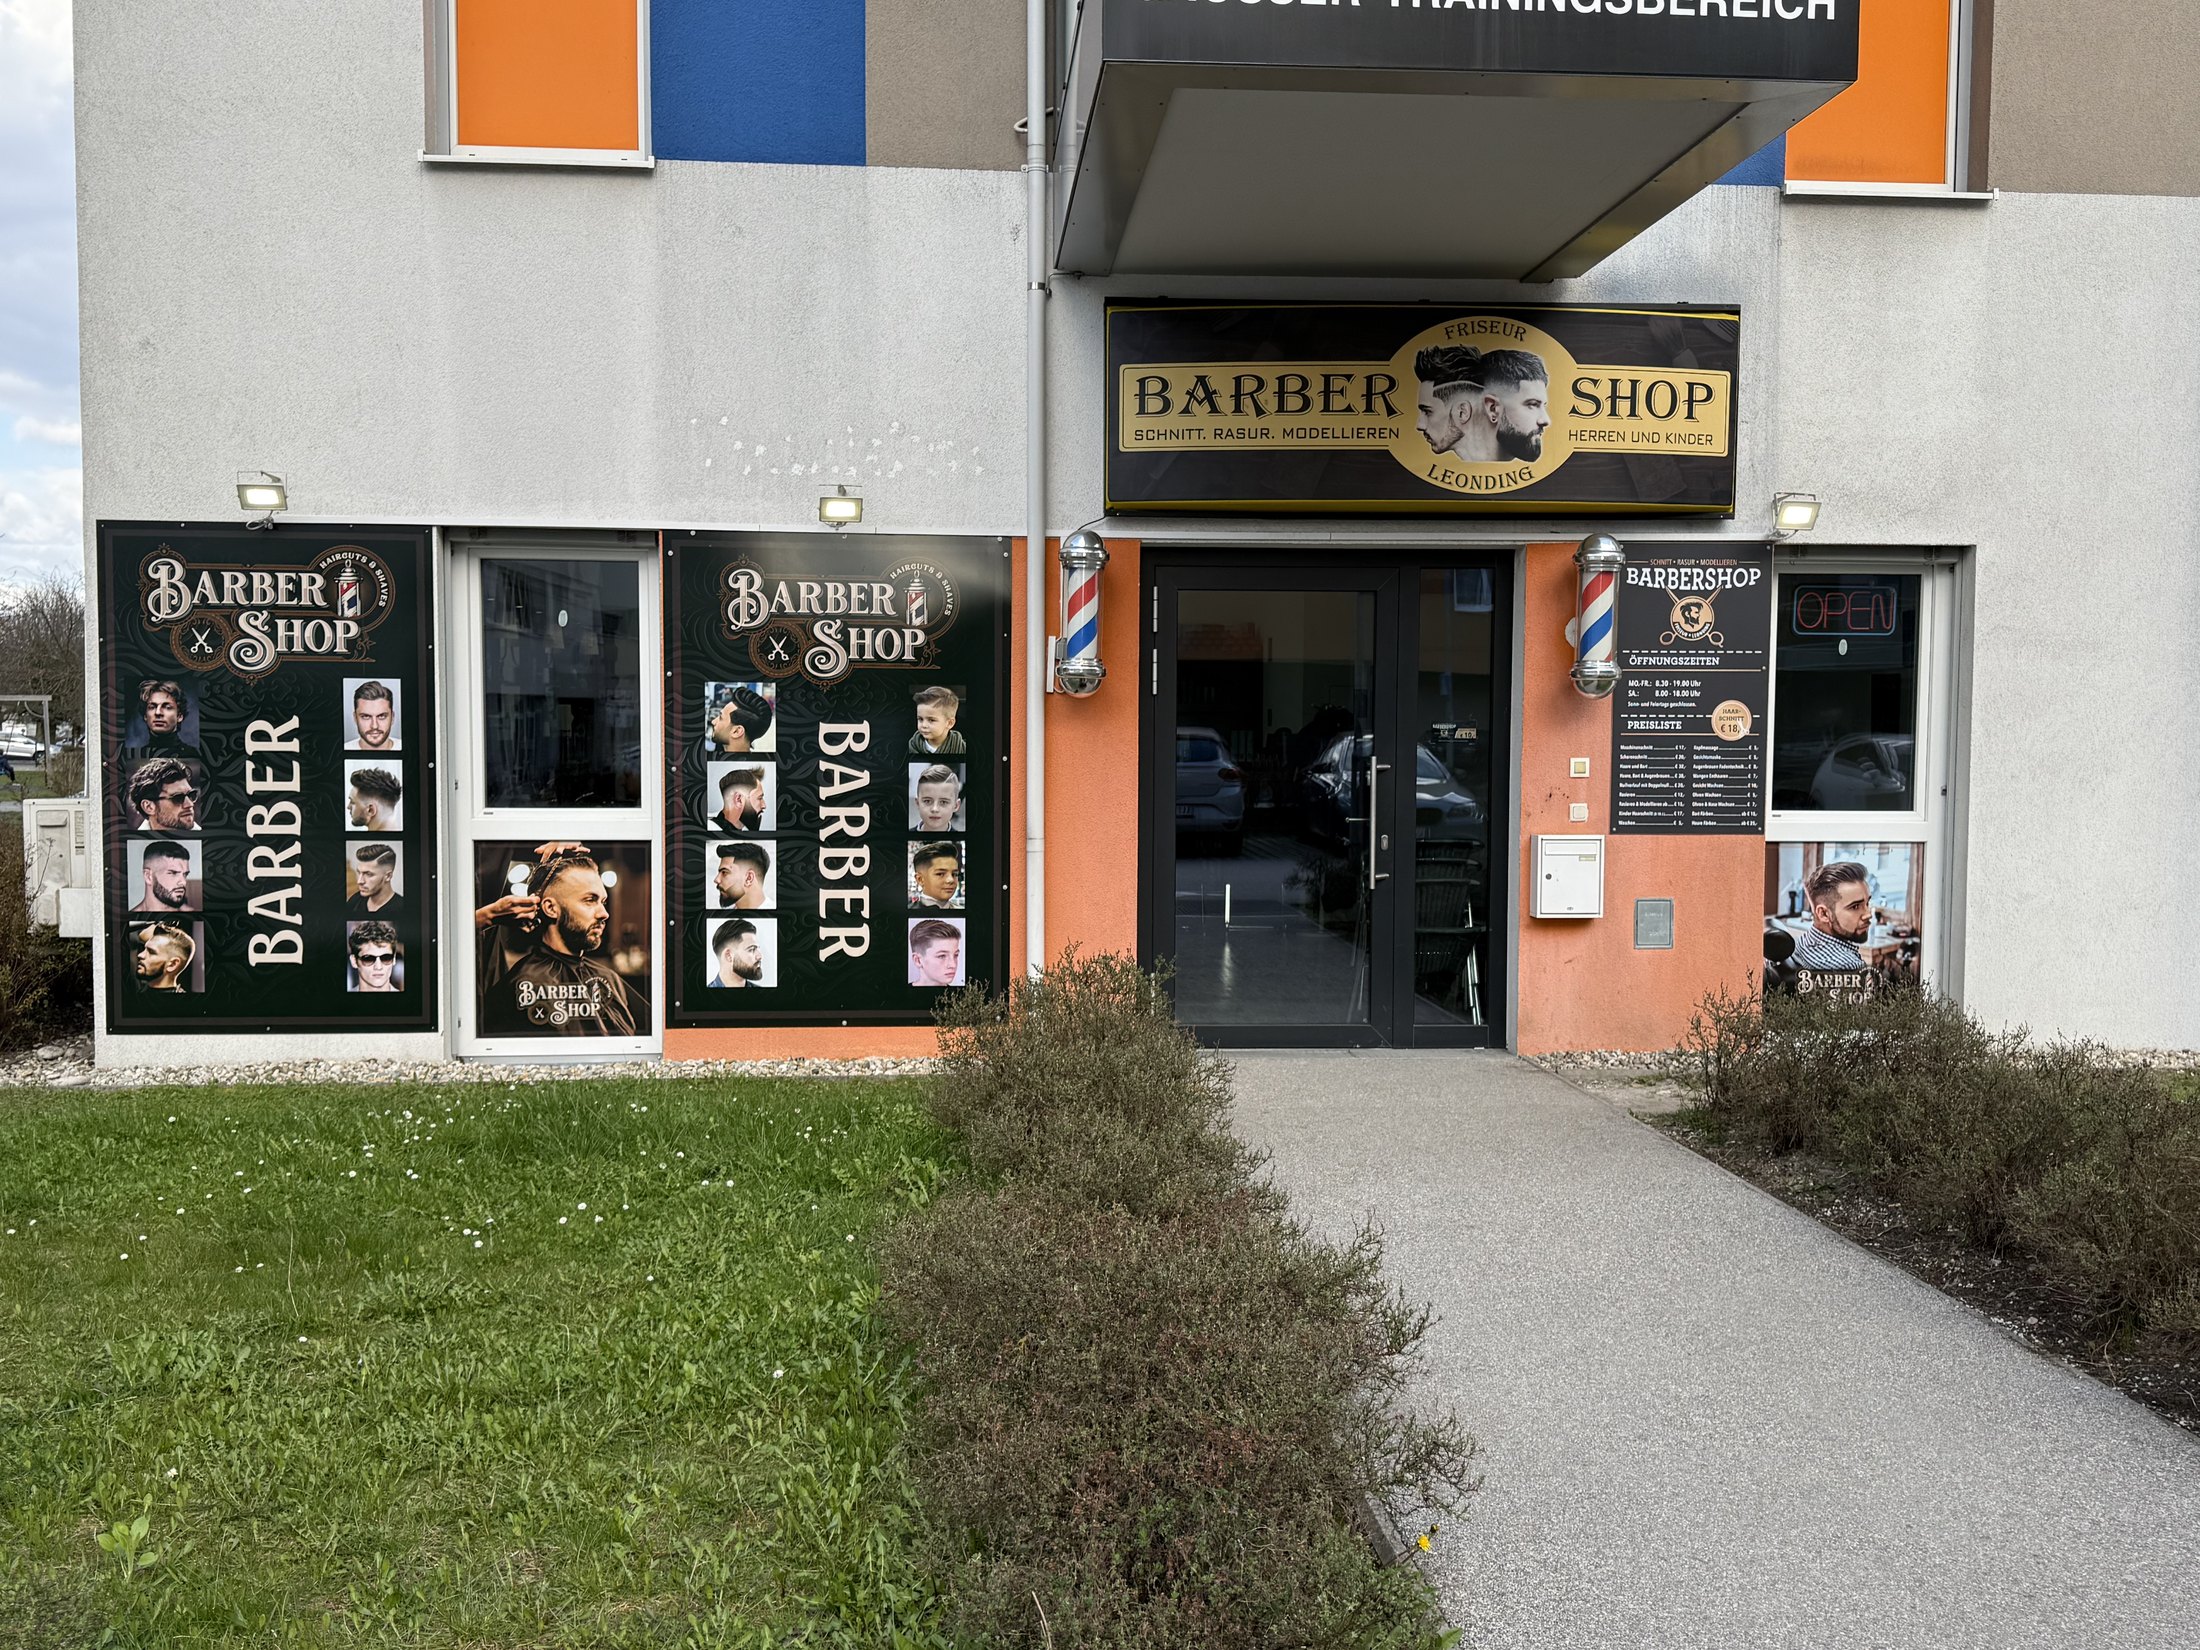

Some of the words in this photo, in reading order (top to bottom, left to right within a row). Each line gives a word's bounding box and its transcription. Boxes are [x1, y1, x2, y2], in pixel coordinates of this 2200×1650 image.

[1444, 320, 1527, 342] FRISEUR
[1134, 374, 1404, 420] BARBER
[1568, 377, 1716, 423] SHOP
[1134, 428, 1206, 441] SCHNITT.
[1213, 428, 1275, 440] RASUR.
[1282, 428, 1400, 440] MODELLIEREN
[1568, 430, 1626, 443] HERREN
[1632, 431, 1660, 444] UND
[1665, 432, 1714, 446] KINDER
[1427, 464, 1535, 490] LEONDING
[148, 558, 329, 623] BARBER
[318, 552, 368, 570] HAIRCUTS
[375, 568, 388, 608] SHAVES
[890, 563, 935, 580] HAIRCUTS
[941, 579, 954, 616] SHAVES
[1626, 568, 1762, 590] BARBERSHOP
[728, 568, 898, 631] BARBER
[1798, 591, 1894, 630] OPEN
[230, 610, 361, 671] SHOP
[804, 619, 928, 678] SHOP
[1629, 655, 1720, 665] ÖFFNUNGSZEITEN
[1627, 721, 1682, 729] PREISLISTE
[1721, 724, 1725, 732] €
[244, 714, 303, 967] BARBER
[818, 720, 870, 962] BARBER
[519, 980, 589, 1006] BARBER
[550, 1000, 600, 1024] SHOP
